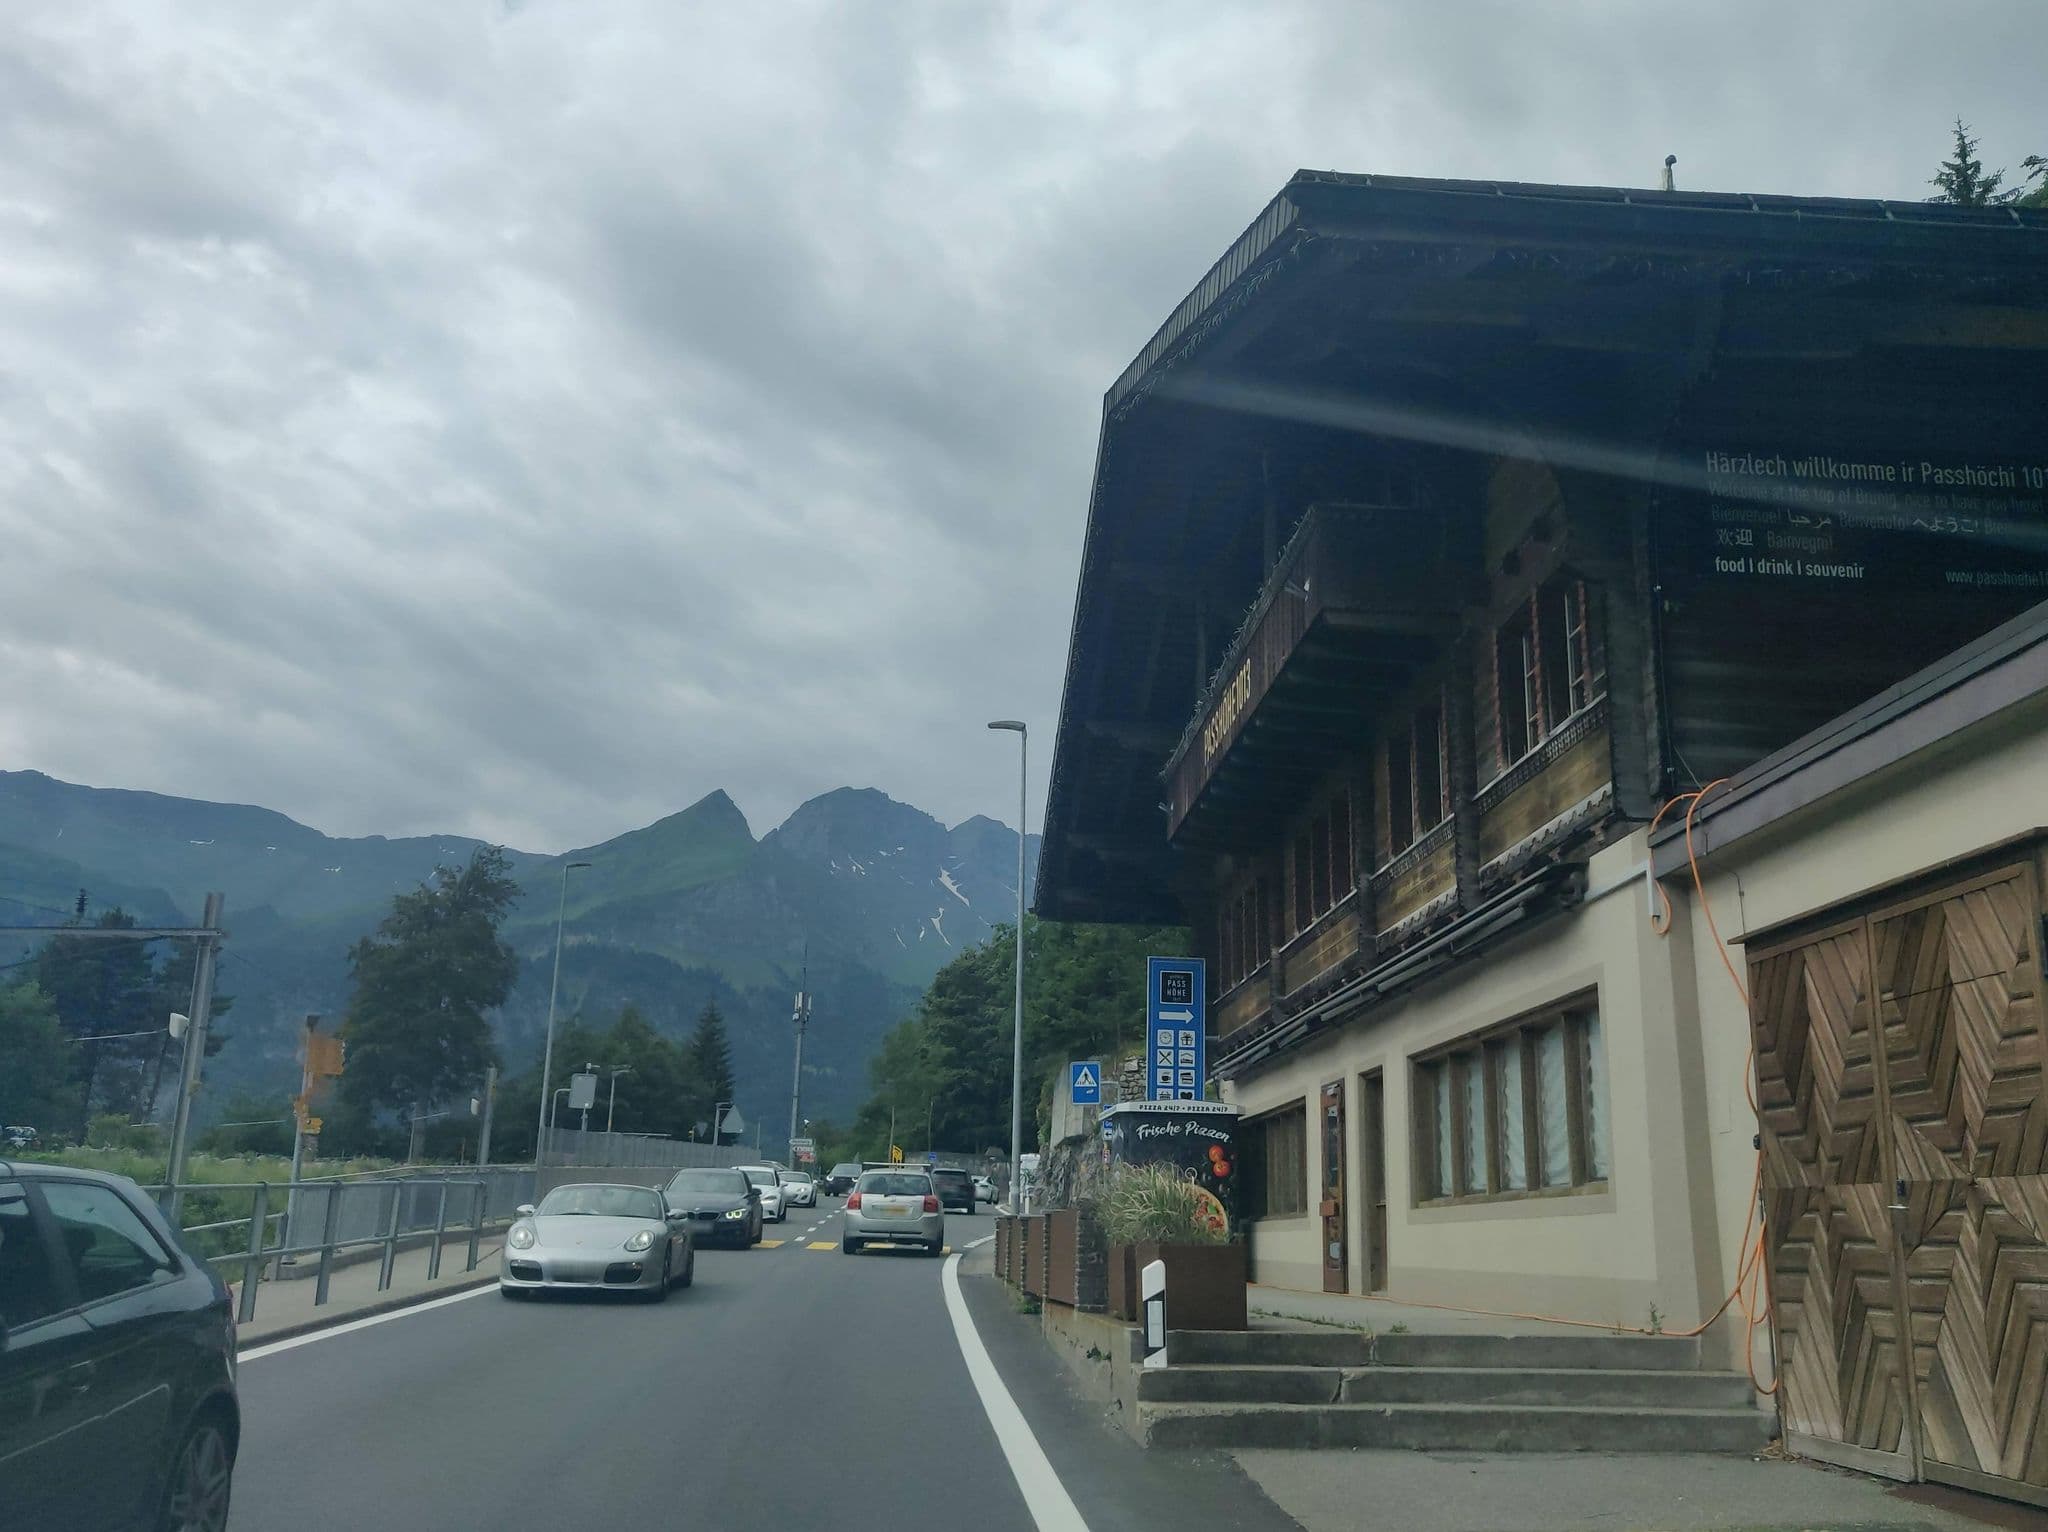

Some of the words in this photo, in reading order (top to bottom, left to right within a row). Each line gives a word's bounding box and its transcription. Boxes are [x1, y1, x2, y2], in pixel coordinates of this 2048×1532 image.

[1706, 451, 1787, 476] Härzlech
[1793, 456, 1895, 482] willkomme
[1902, 461, 1914, 482] ir
[1921, 462, 2016, 488] Passhöchi
[2022, 466, 2048, 488] 10
[1715, 556, 1745, 573] food
[1757, 558, 1794, 575] drink
[1806, 562, 1865, 578] souvenir
[1167, 979, 1186, 988] PASS
[1136, 1120, 1182, 1141] Frische
